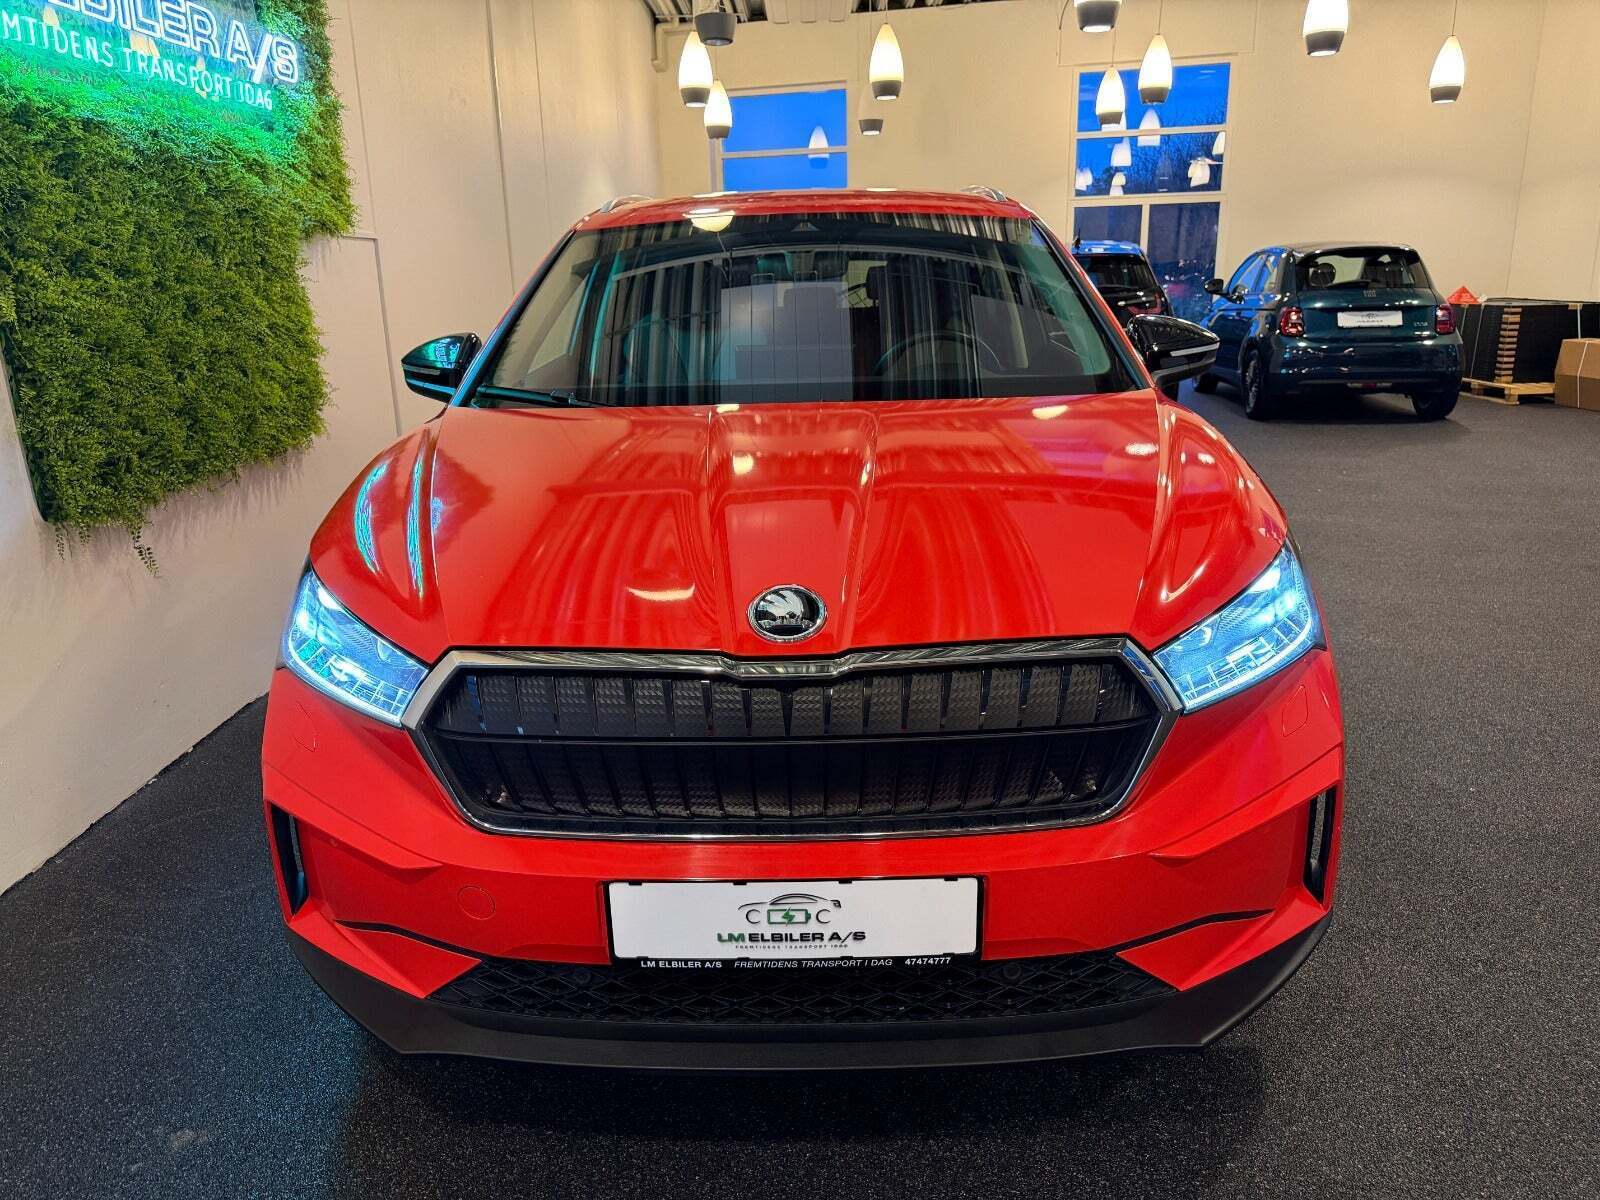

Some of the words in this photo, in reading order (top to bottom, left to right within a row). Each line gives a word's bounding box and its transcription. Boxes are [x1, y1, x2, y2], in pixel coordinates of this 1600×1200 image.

[48, 0, 219, 58] ILER
[228, 20, 299, 84] A/S
[122, 47, 232, 98] TRANSPORT
[717, 932, 746, 943] LM
[748, 932, 825, 942] ELBILER
[828, 931, 866, 943] A/S
[640, 960, 656, 968] LM
[658, 960, 702, 968] ELBILER
[801, 960, 862, 968] TRANSPORT
[871, 959, 893, 967] DAG
[904, 957, 951, 966] 47474777
